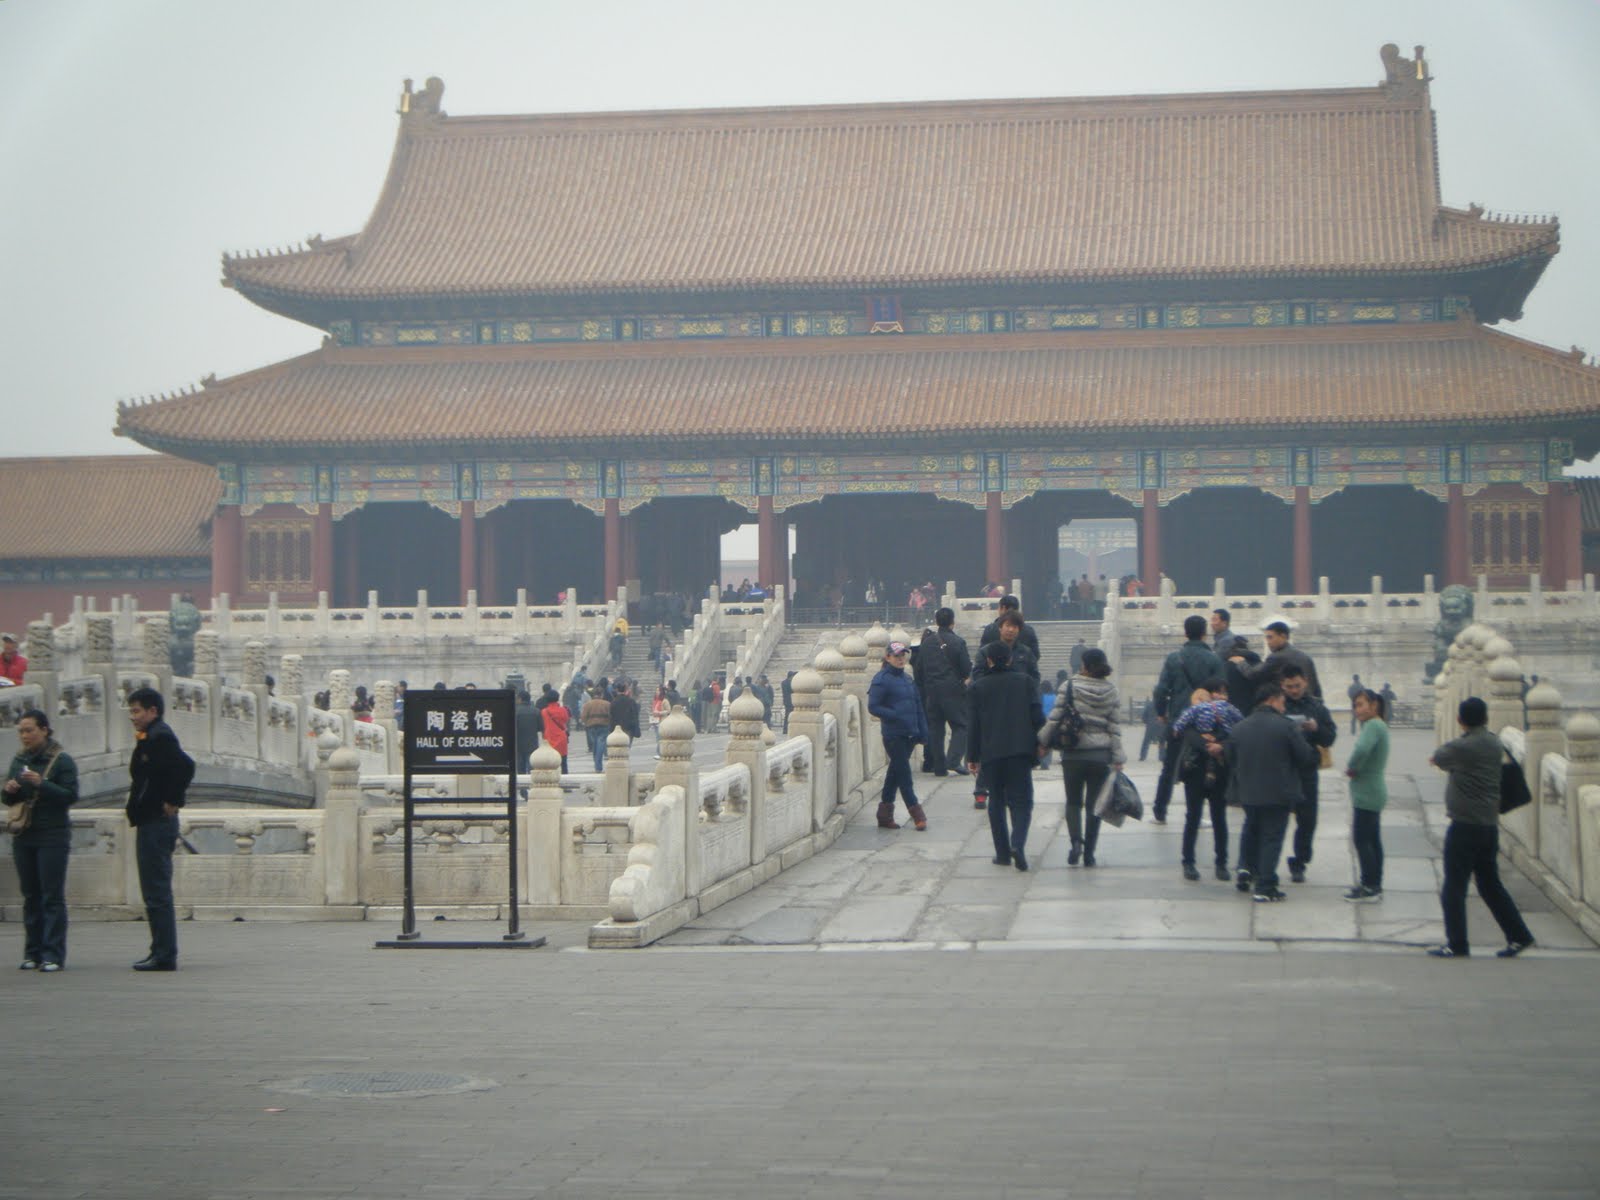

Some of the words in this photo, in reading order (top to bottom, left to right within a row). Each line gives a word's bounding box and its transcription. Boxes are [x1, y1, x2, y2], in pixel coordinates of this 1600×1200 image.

[427, 710, 493, 731] 陶瓷馆
[416, 737, 439, 748] HALL
[442, 737, 455, 748] OF
[458, 736, 504, 748] CERAMICS
